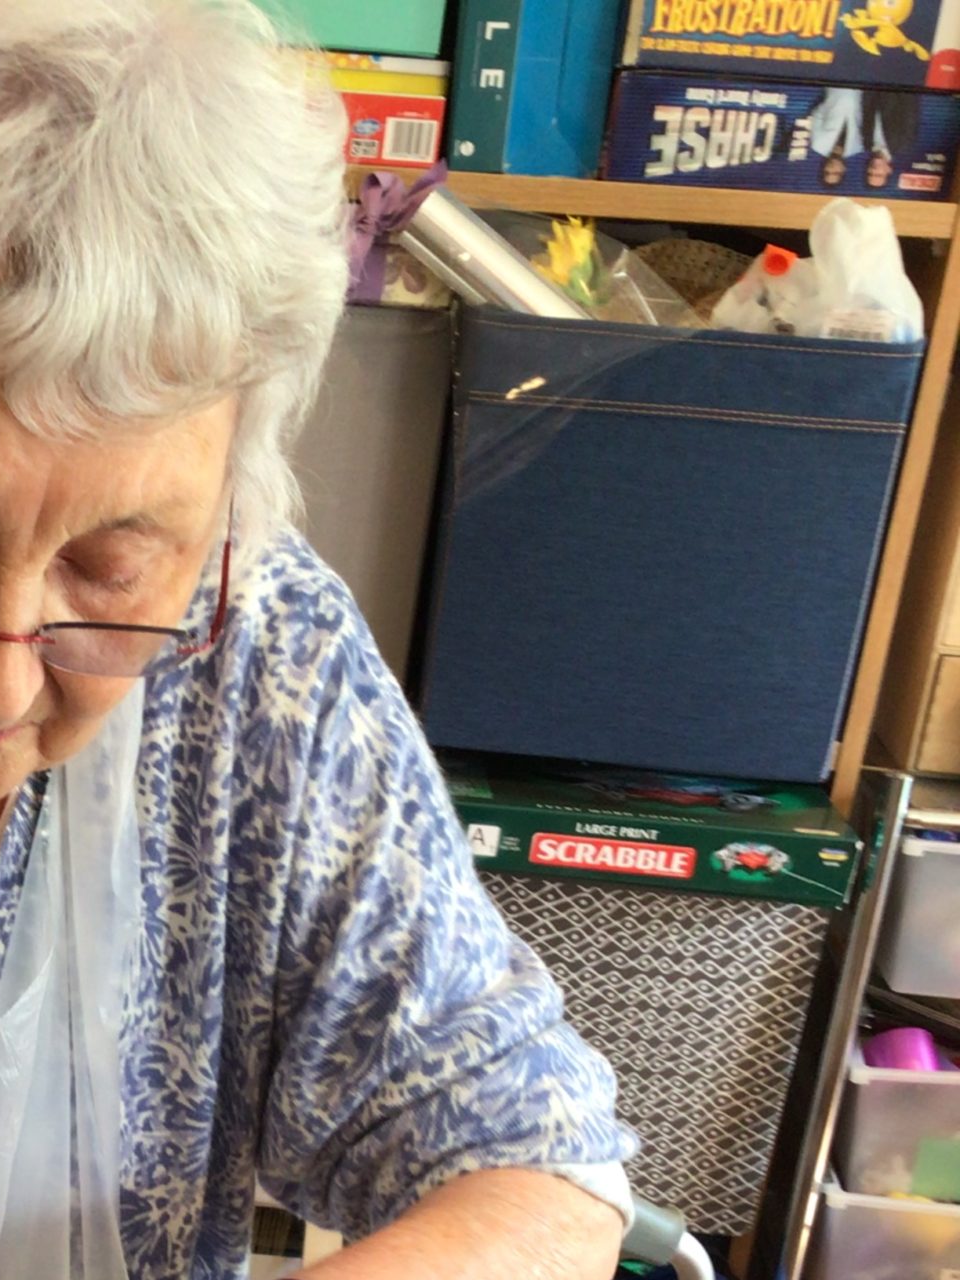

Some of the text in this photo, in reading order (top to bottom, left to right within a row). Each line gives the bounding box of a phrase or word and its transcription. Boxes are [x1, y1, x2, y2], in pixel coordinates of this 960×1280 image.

[644, 105, 777, 177] CHASE
[575, 817, 660, 840] LARGE PRINT
[536, 838, 691, 873] SCRABBLE
